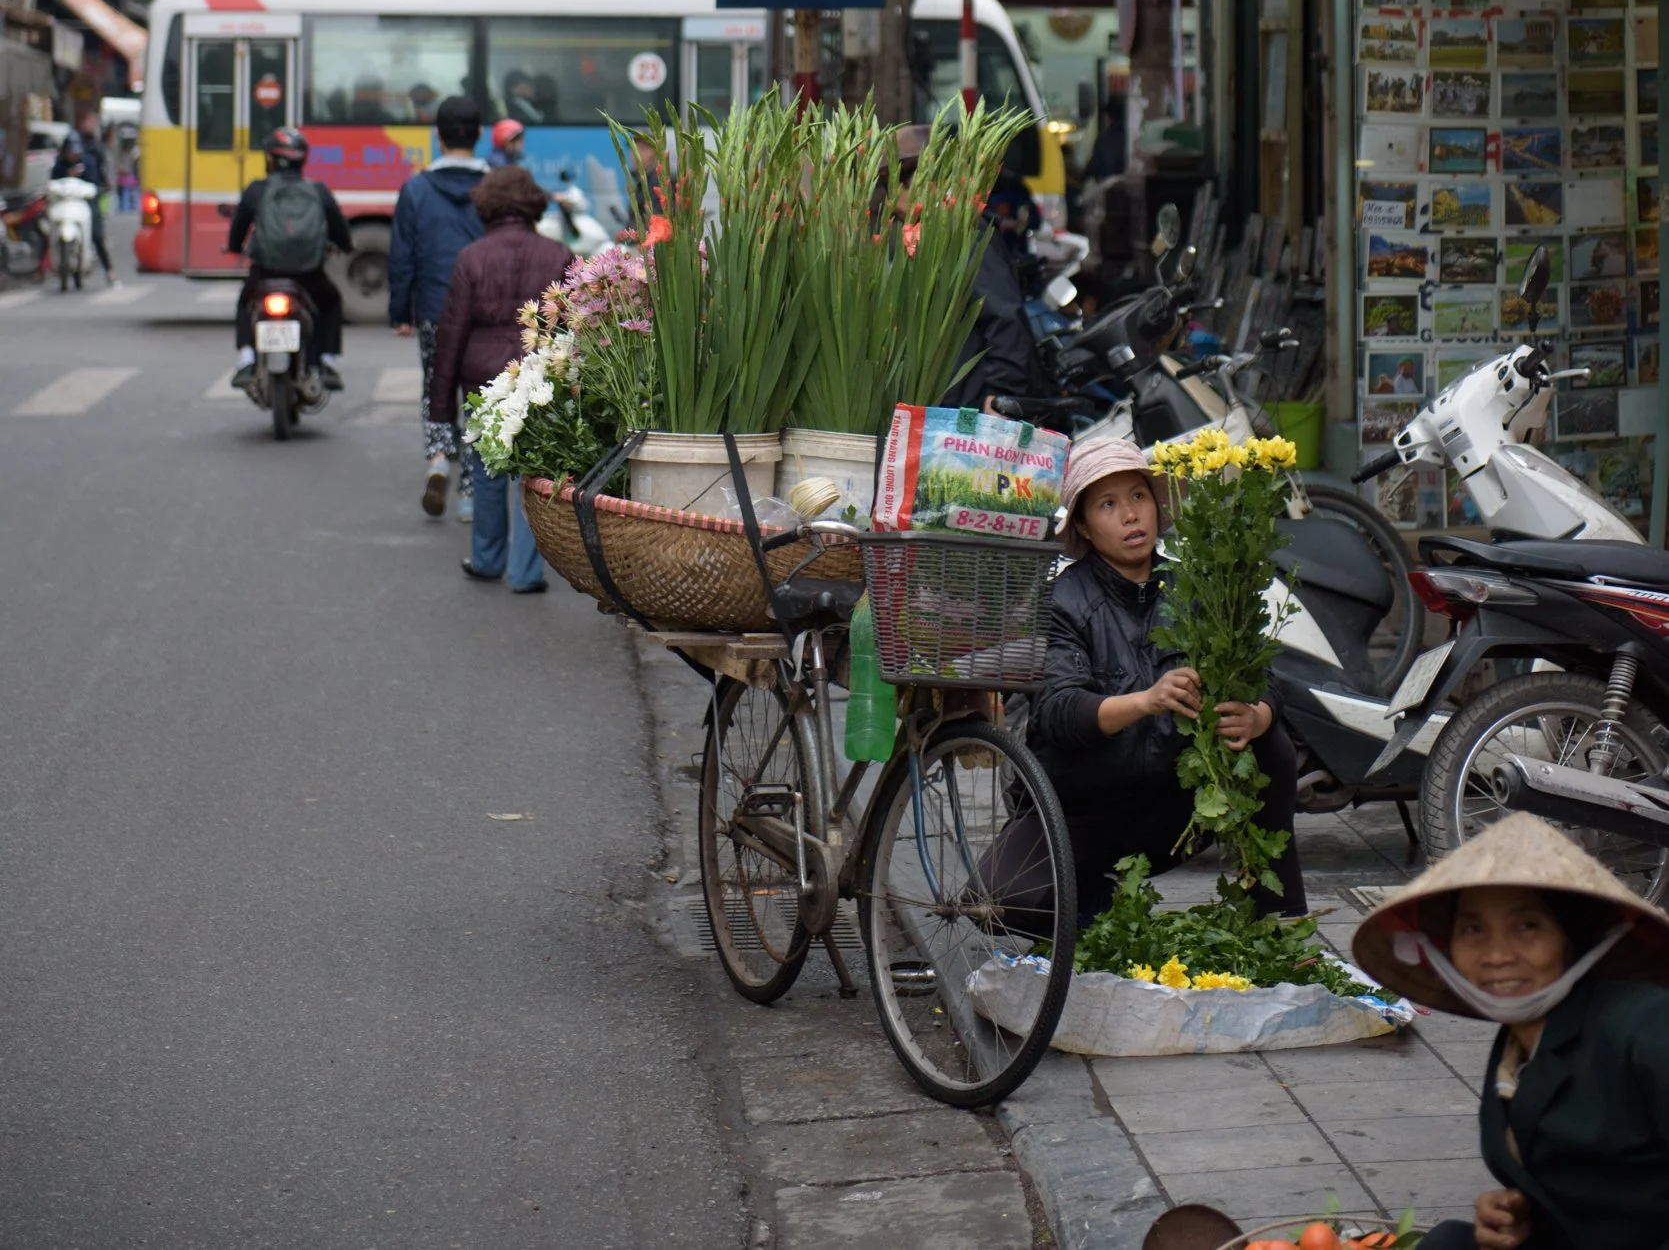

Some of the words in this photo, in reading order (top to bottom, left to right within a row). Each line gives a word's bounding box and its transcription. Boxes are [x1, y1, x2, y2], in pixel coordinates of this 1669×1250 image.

[944, 437, 989, 456] PHÂN
[994, 445, 1020, 463] BÓN
[956, 510, 1041, 537] 8-2-8+TE
